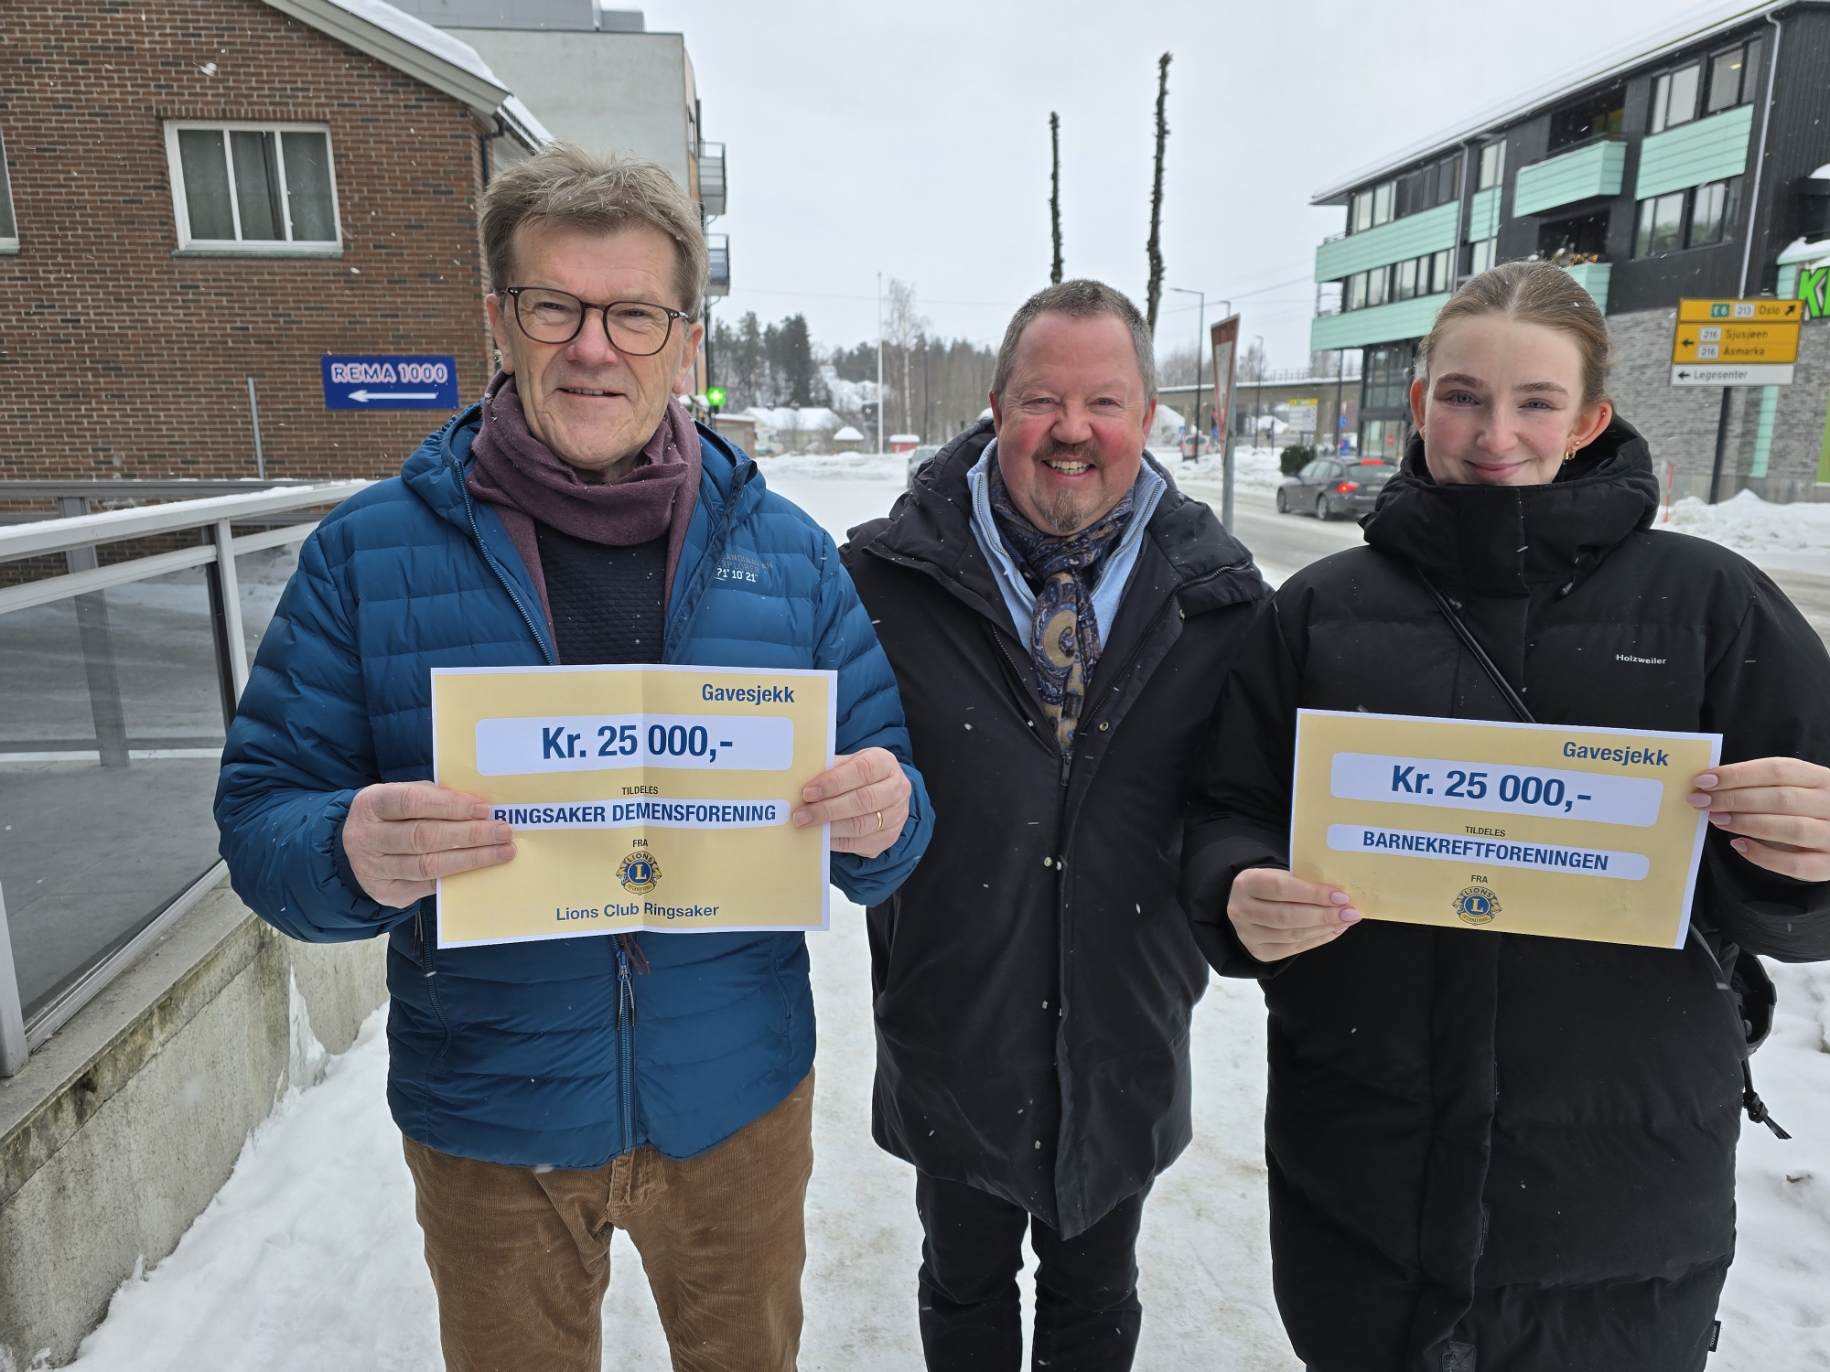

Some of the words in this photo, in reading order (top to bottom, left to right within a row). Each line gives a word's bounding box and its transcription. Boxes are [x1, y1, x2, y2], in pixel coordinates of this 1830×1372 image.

[1737, 306, 1752, 316] 213
[1759, 305, 1781, 316] Oslo
[1703, 330, 1718, 339] 216
[1726, 329, 1769, 341] Sjusjøen
[1701, 348, 1716, 357] 216
[331, 363, 397, 383] REMA
[398, 363, 448, 383] 1000
[1694, 369, 1748, 381] Legesenter
[718, 559, 760, 574] XPLORER
[1616, 653, 1667, 665] Holzweiler
[702, 683, 795, 706] Gavesjekk
[541, 725, 587, 760] Kr.
[598, 724, 639, 758] 25
[648, 724, 734, 763] 000,-
[1562, 740, 1669, 768] Gavesjekk
[621, 785, 659, 797] TILDELES
[1391, 764, 1434, 795] Kr.
[1444, 769, 1489, 800] 25
[1499, 774, 1592, 813] 000,-
[494, 806, 606, 825] RINGSAKER
[612, 802, 776, 823] DEMENSFORENING
[1465, 825, 1506, 838] TILDELES
[632, 838, 649, 848] FRA
[1363, 830, 1609, 871] BARNEKREFTFORENINGEN
[626, 852, 653, 863] LIONS
[634, 864, 647, 880] L
[1470, 874, 1488, 884] FRA
[1464, 887, 1493, 898] LIONS
[556, 904, 599, 921] Lions
[603, 902, 640, 918] Club
[643, 902, 720, 920] Ringsaker
[1470, 898, 1484, 912] L
